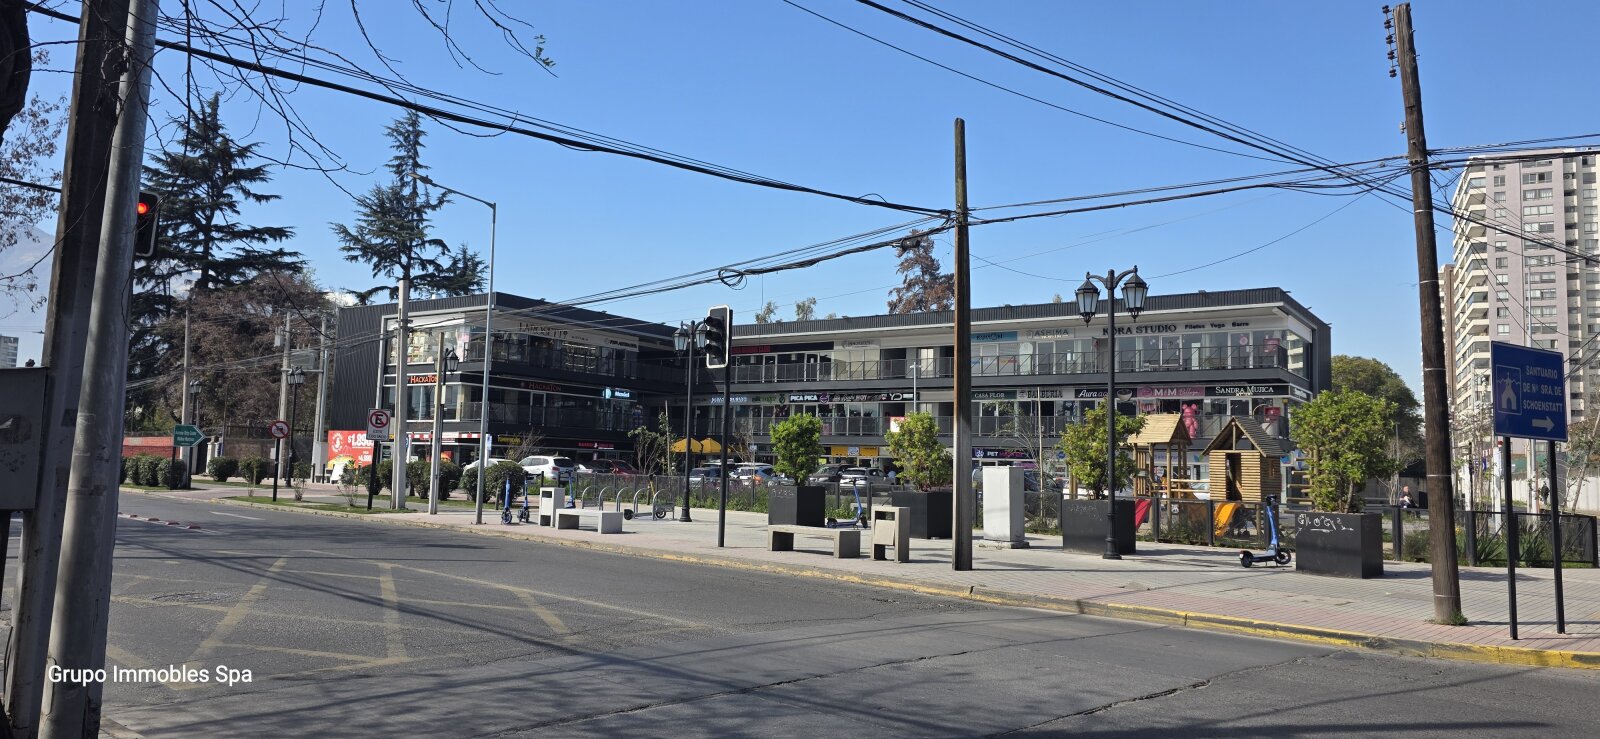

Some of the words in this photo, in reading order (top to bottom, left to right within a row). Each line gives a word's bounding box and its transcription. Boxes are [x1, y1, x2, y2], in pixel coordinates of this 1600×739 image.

[1135, 324, 1177, 334] STUDIO
[1184, 323, 1206, 331] Pilates
[1526, 365, 1558, 380] SANTUARIO
[1077, 389, 1098, 398] Aura
[1215, 386, 1246, 394] SANDRA
[1246, 385, 1274, 394] MUJICA
[1522, 383, 1531, 393] DE
[1554, 386, 1562, 396] DE
[1522, 399, 1563, 413] SCHOENSTATT
